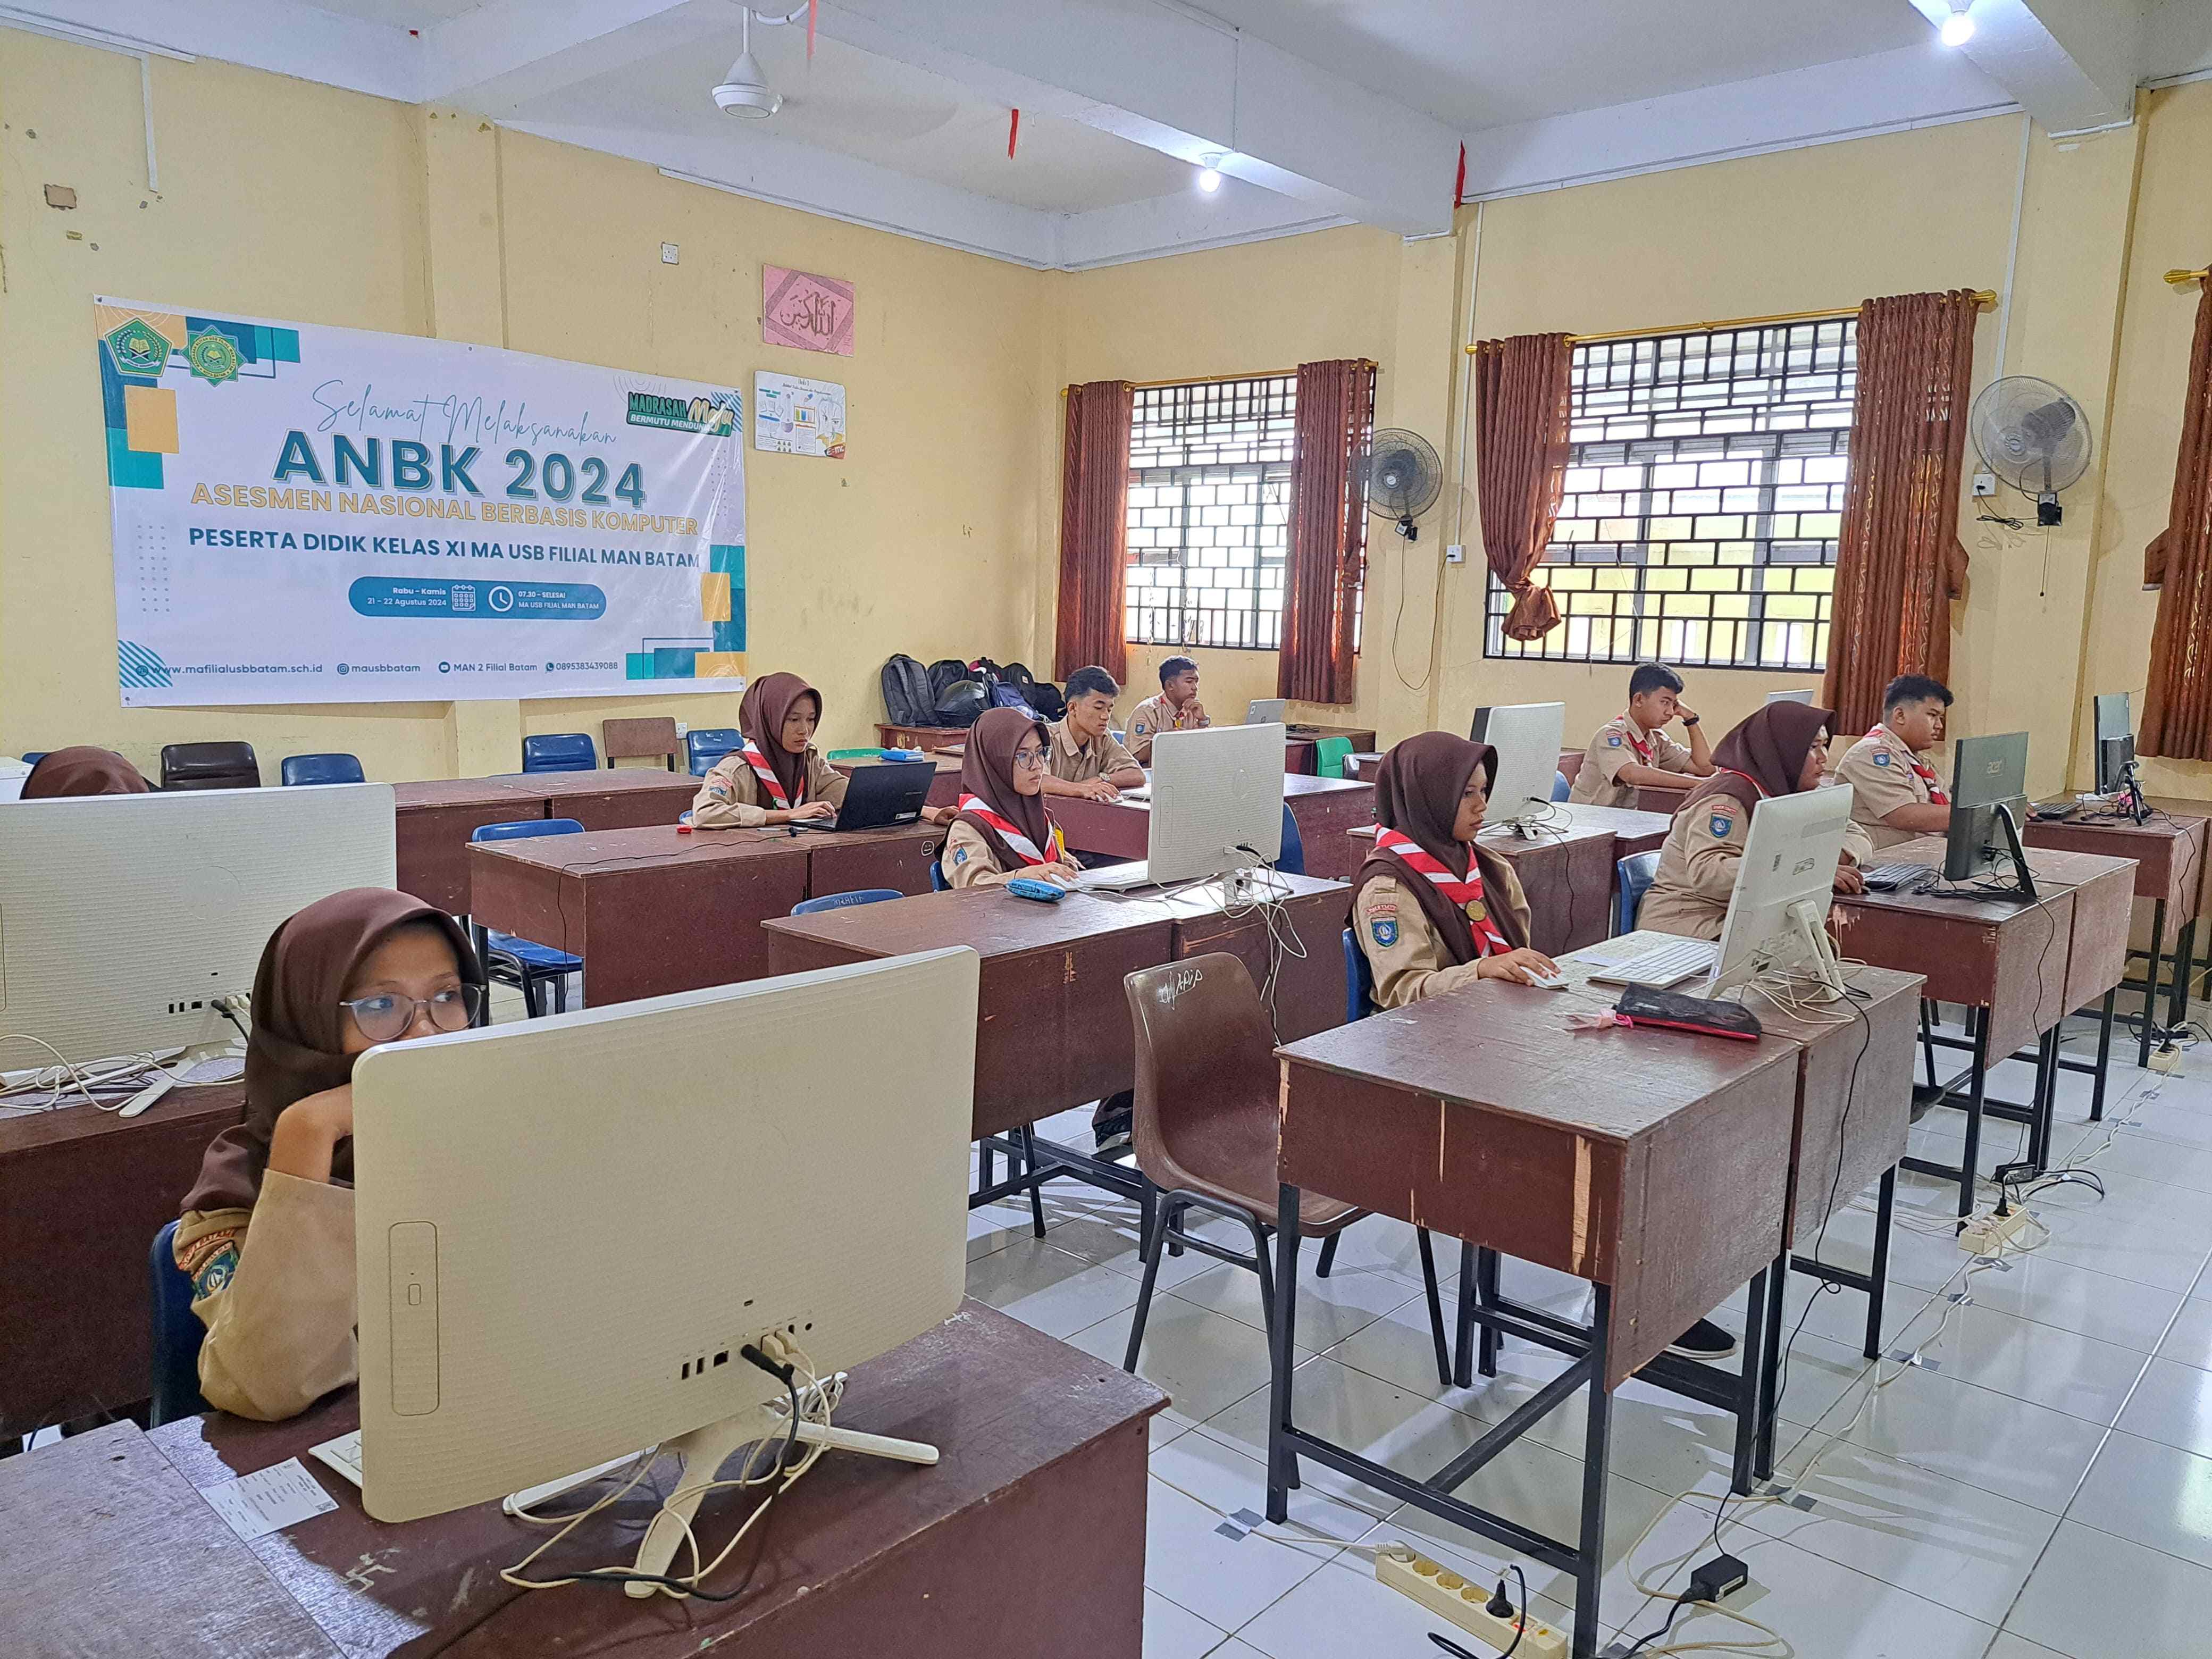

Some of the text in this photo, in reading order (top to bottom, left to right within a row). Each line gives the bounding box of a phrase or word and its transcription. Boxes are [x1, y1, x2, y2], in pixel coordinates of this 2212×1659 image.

[312, 380, 616, 447] Selamat Melaksanakan
[629, 392, 734, 432] MADRASAH Maju
[630, 414, 669, 426] BERMUTU
[270, 428, 646, 510] ANBK 2024
[191, 482, 698, 535] ASESMEN NASIONAL BERBASIS KOMPUTER
[189, 527, 700, 568] PESERTA DIDIK KELAS XI MA USB FILIAL MAN BATAM
[395, 599, 426, 607] Agustus
[152, 663, 323, 675] www.mafilialusbbatam.sch.id
[351, 663, 421, 673] mausbbatam
[485, 663, 506, 672] Filial
[509, 663, 538, 672] Batam
[556, 661, 618, 671] 0895383439088
